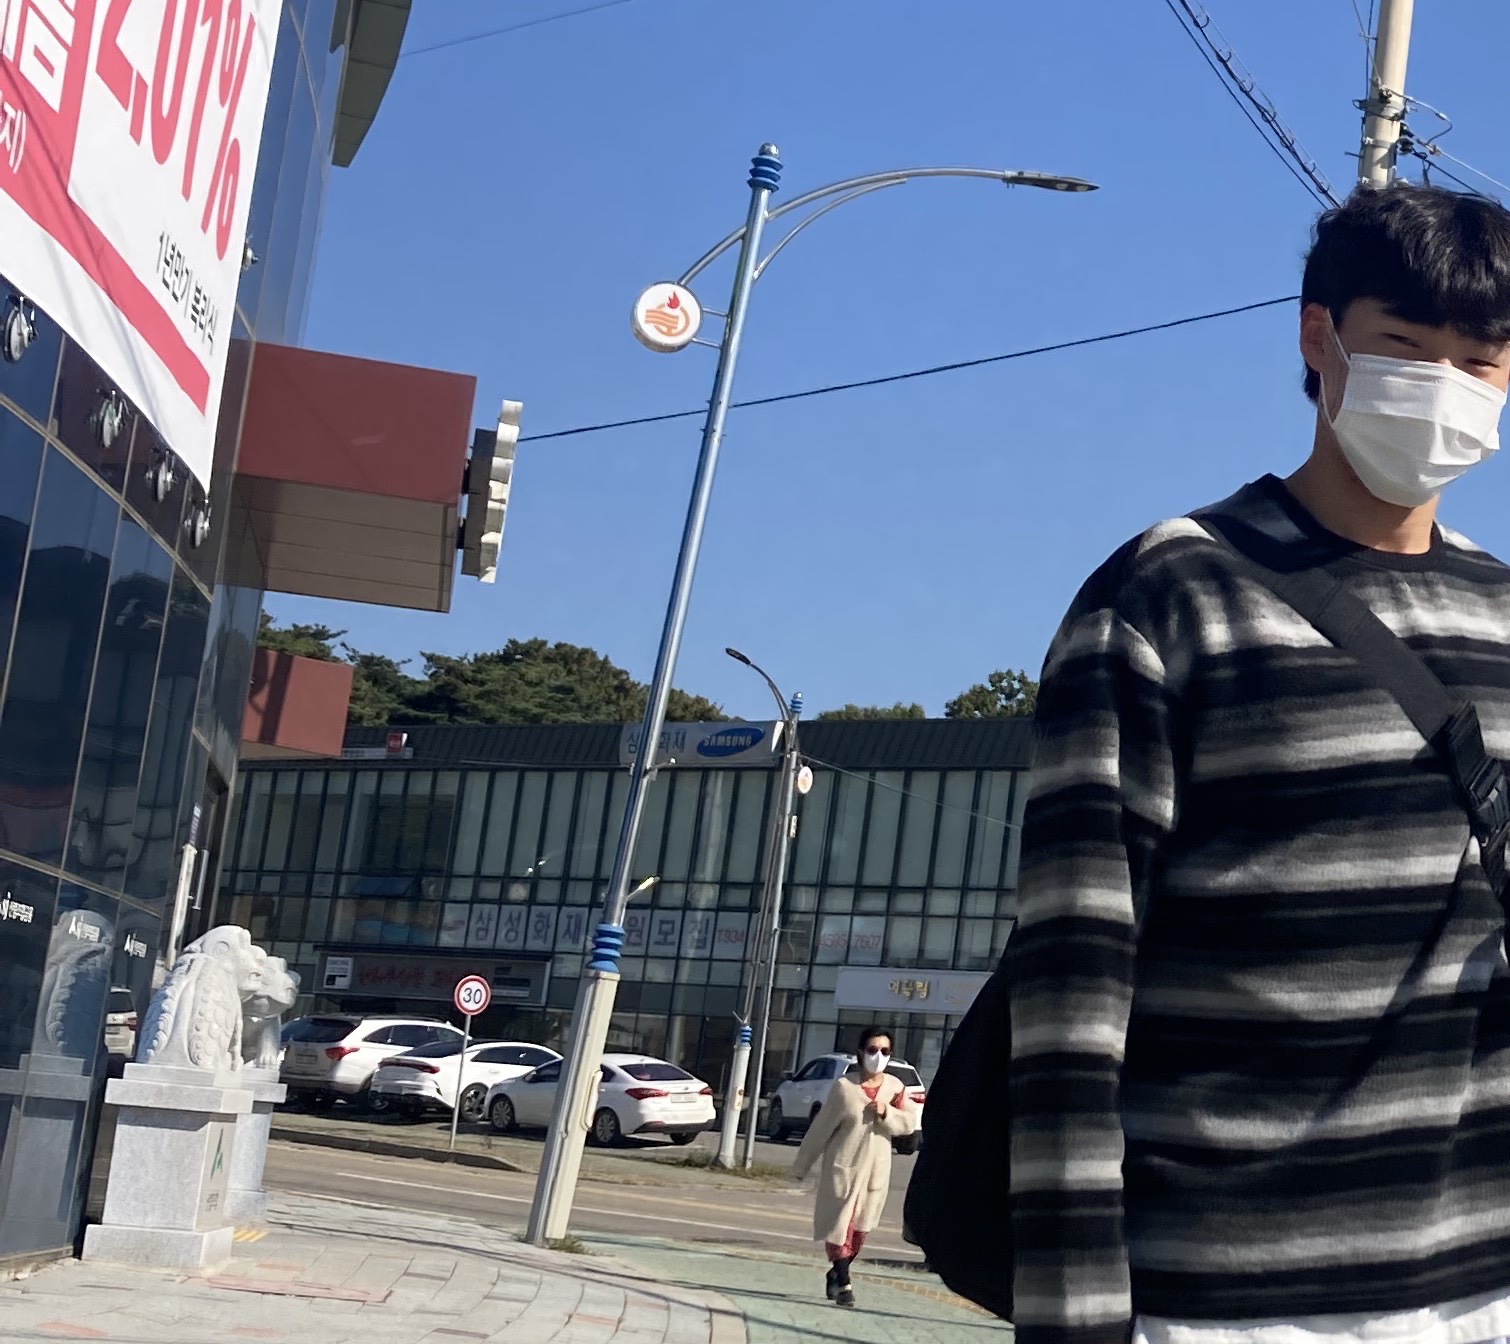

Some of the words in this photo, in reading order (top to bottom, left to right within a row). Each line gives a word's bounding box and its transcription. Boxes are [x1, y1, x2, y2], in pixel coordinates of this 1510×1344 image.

[156, 230, 193, 319] 1년만기
[190, 280, 219, 356] 복리식
[627, 728, 687, 754] 삼화재
[703, 734, 752, 748] SAMSUNG
[474, 909, 581, 943] 삼성화재
[462, 987, 483, 1005] 30
